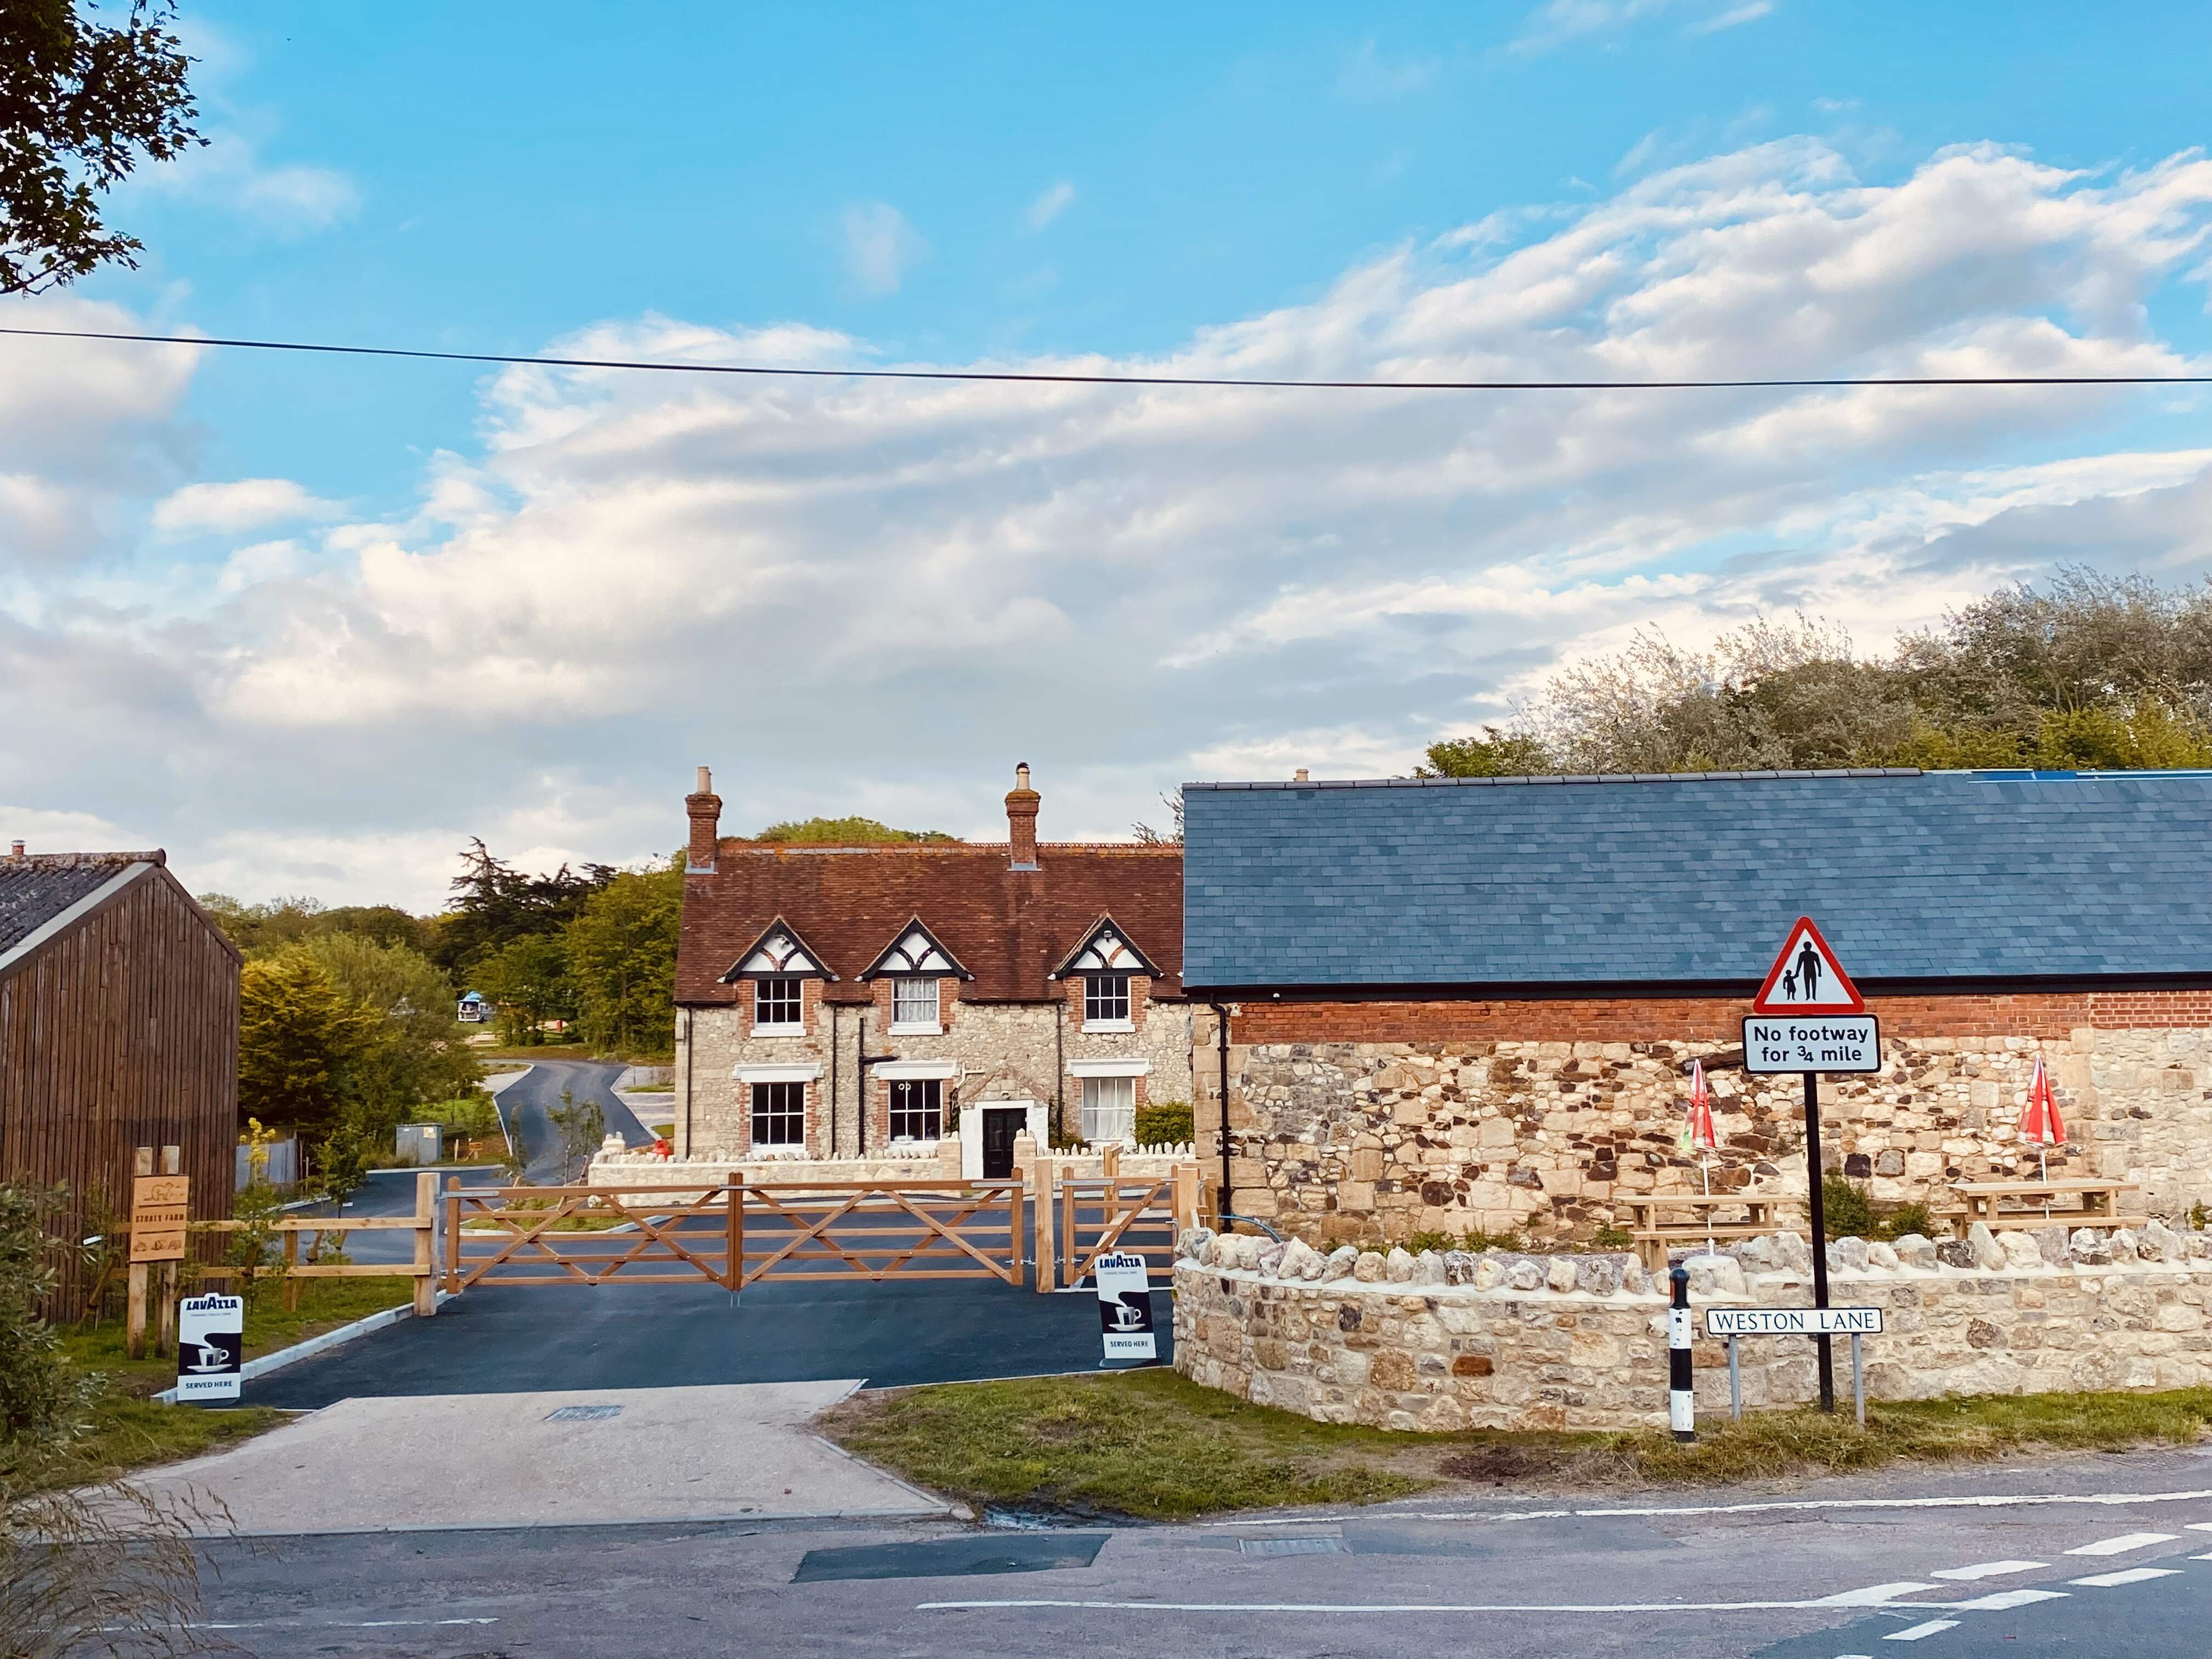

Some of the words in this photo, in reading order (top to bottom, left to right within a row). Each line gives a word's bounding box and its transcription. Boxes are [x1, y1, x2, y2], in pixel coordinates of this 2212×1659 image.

[1754, 1026, 1781, 1041] No
[1789, 1026, 1868, 1043] footway
[1762, 1047, 1789, 1062] for
[1821, 1046, 1861, 1062] mile
[1099, 1255, 1141, 1268] LAVAZZA
[186, 1296, 238, 1310] LAVAZZA
[1715, 1313, 1804, 1330] WESTON
[1819, 1312, 1875, 1329] LANE
